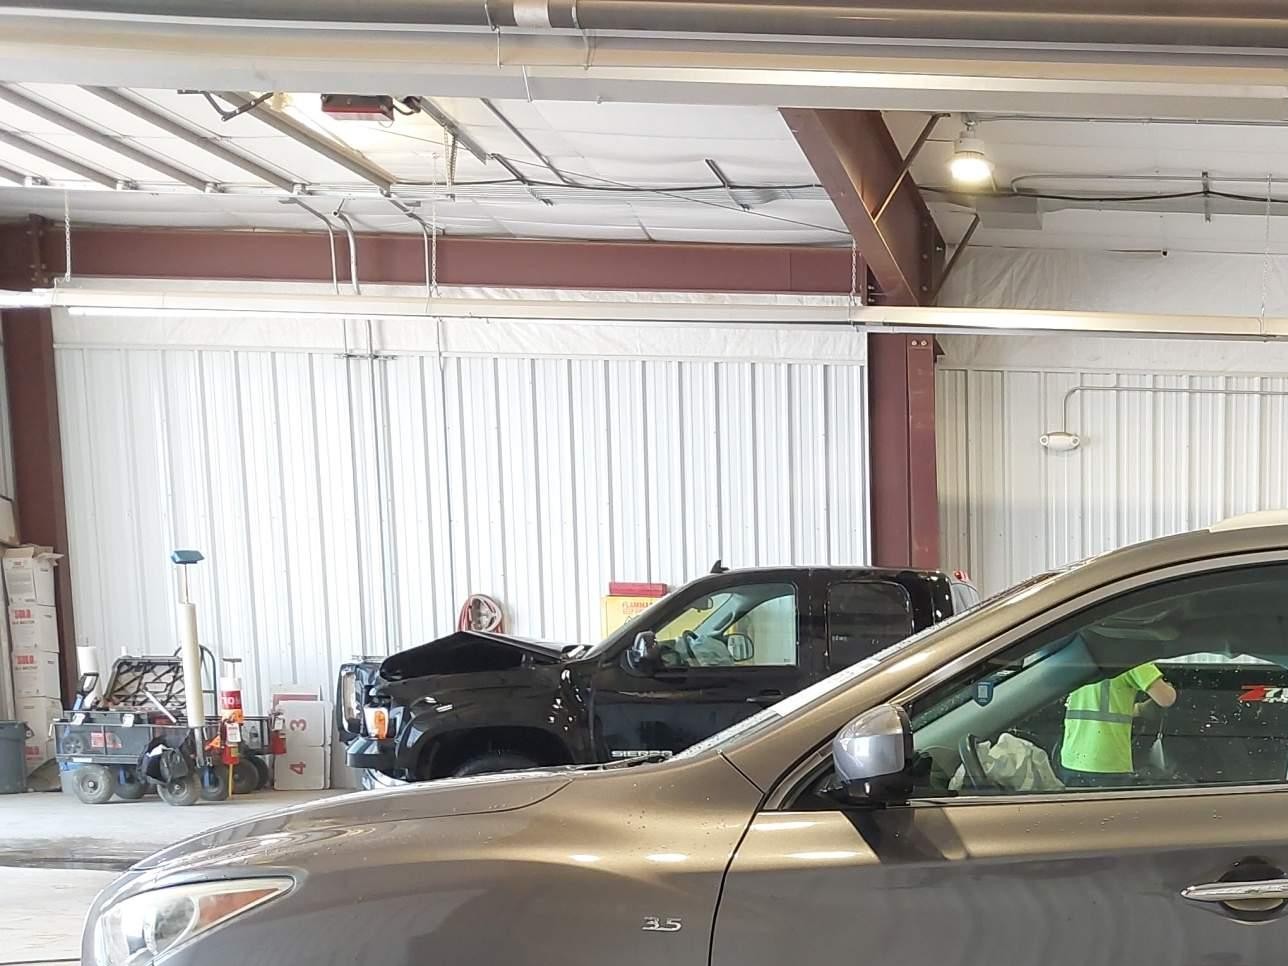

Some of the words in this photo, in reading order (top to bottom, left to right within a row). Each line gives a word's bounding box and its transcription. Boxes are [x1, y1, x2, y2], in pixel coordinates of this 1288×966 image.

[290, 719, 307, 732] 3
[611, 750, 673, 759] SIERRA
[289, 761, 306, 775] 4
